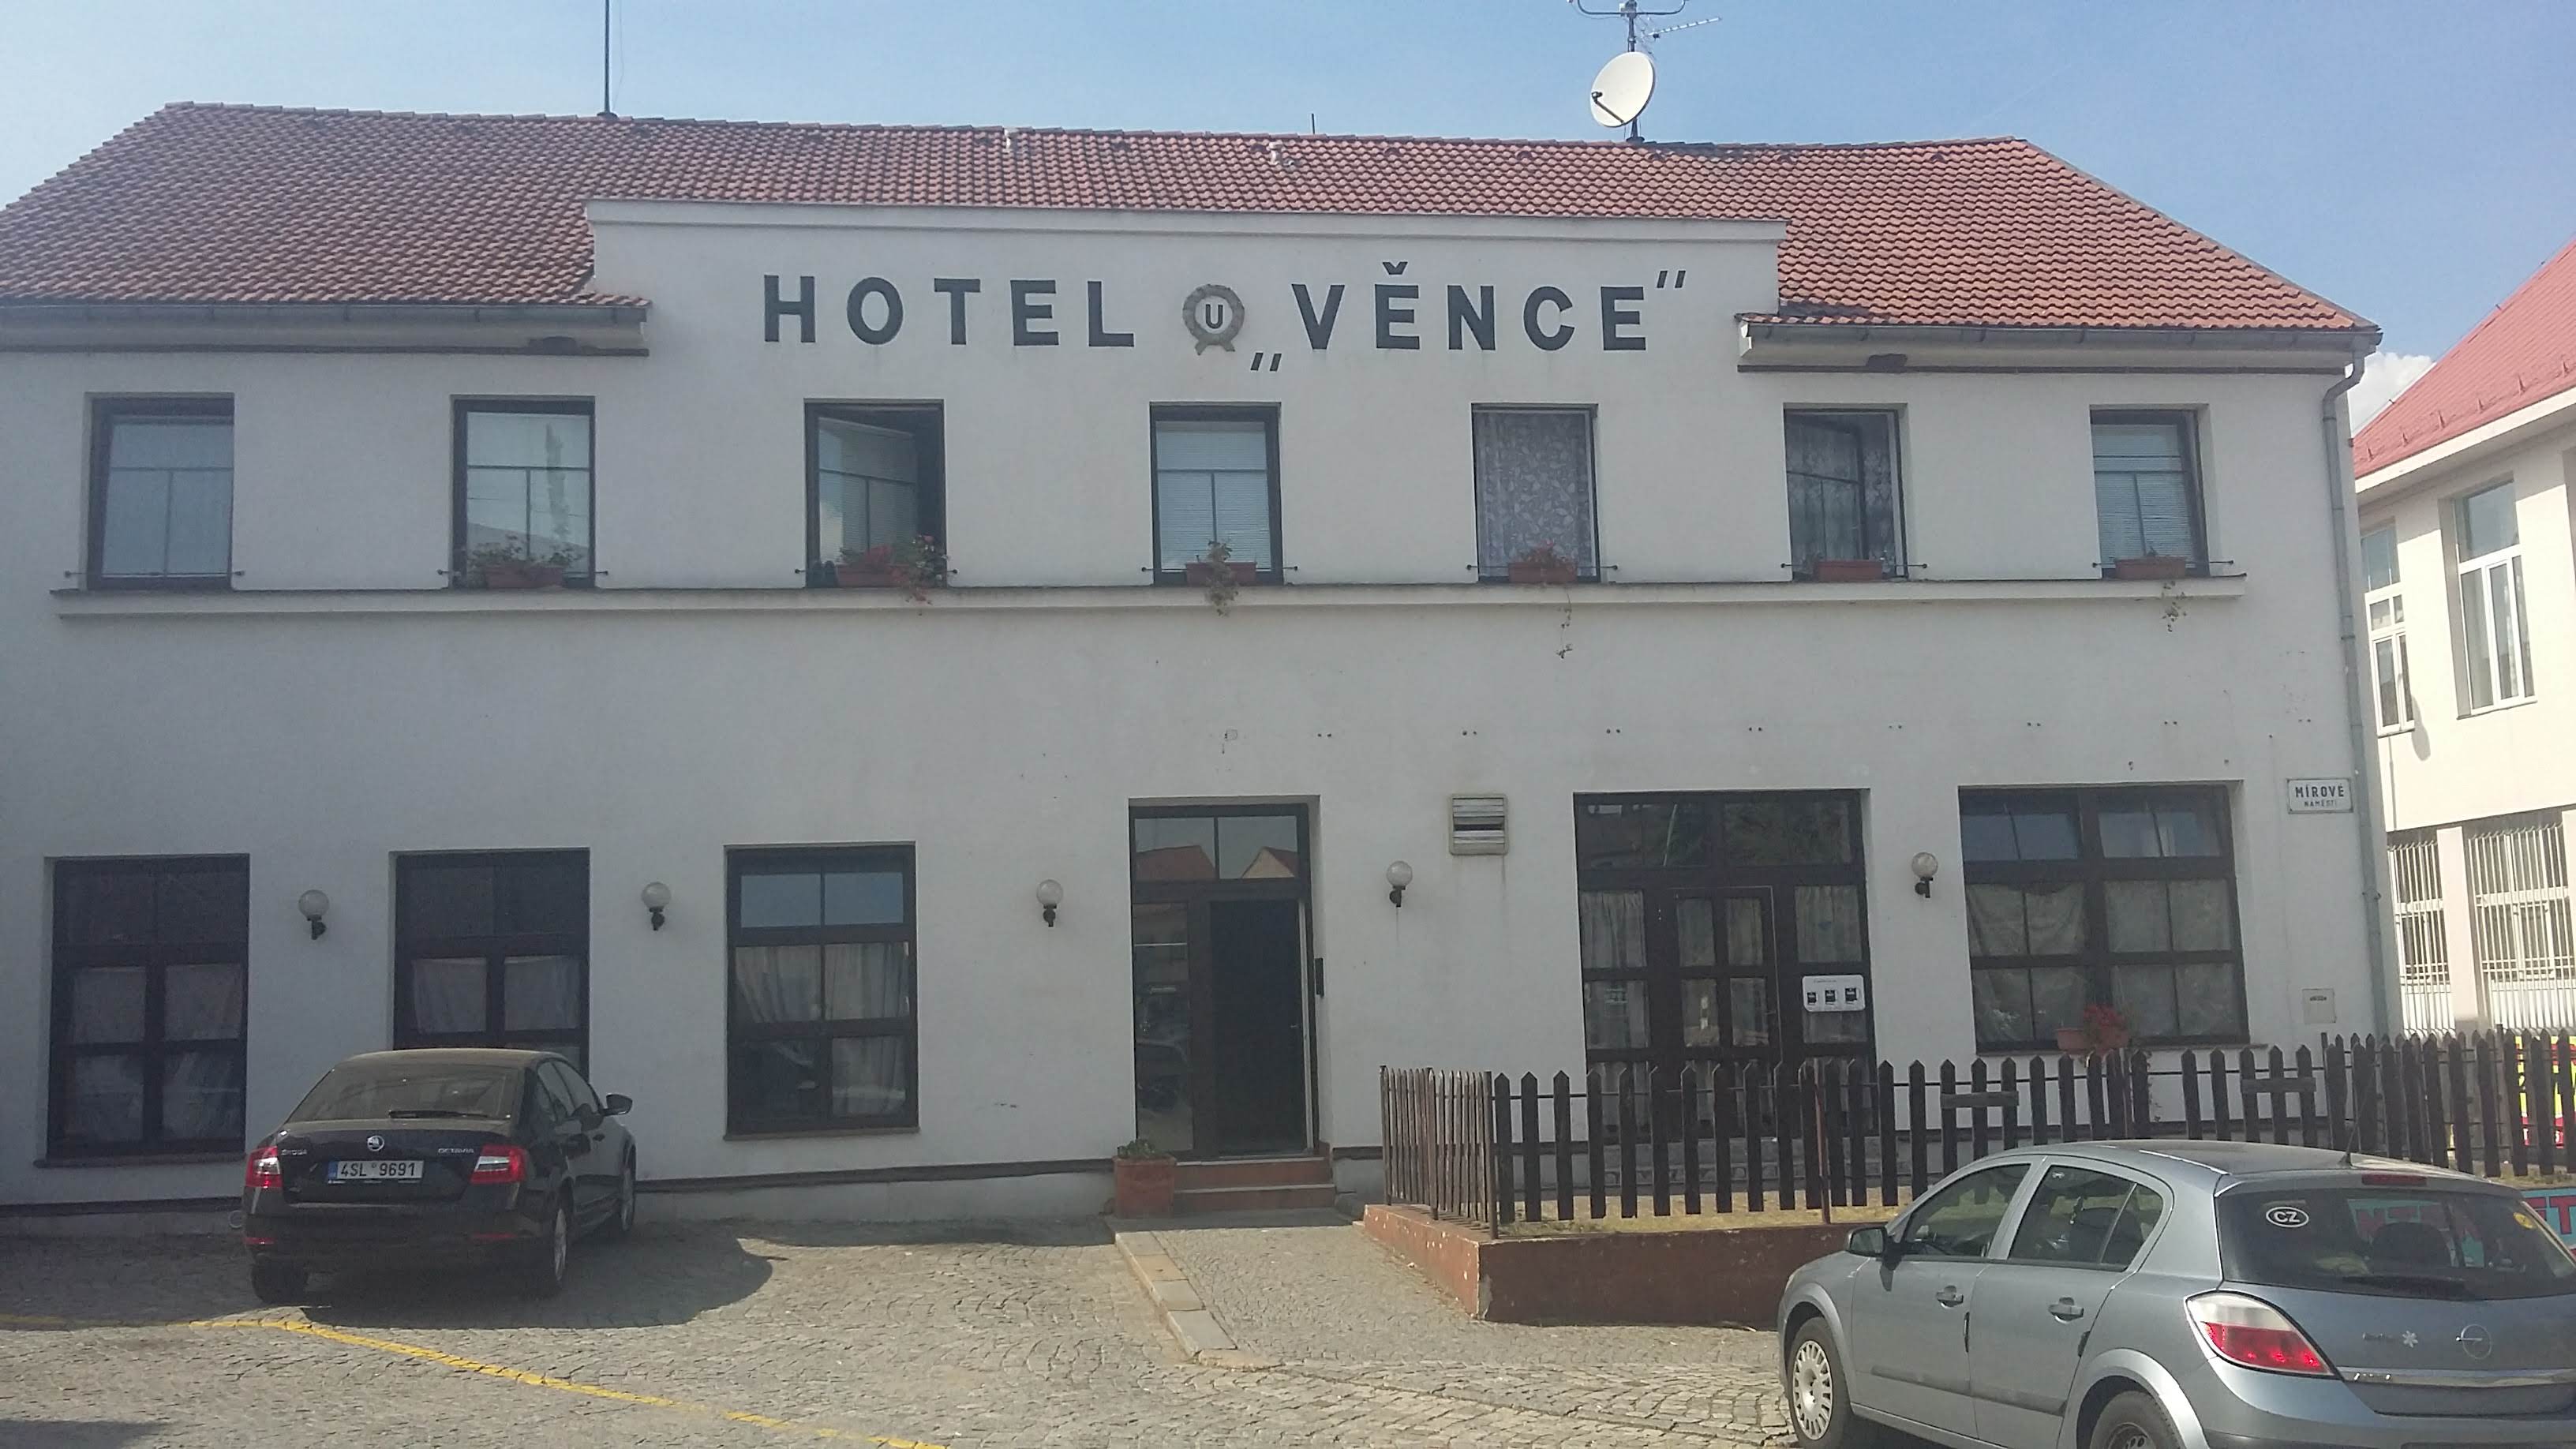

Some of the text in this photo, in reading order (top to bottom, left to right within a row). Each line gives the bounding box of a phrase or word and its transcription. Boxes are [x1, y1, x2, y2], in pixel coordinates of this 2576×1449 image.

[763, 274, 1135, 348] HOTEL
[1205, 303, 1224, 329] U
[340, 1162, 415, 1177] 4SL 9691
[2274, 1211, 2301, 1222] CZ
